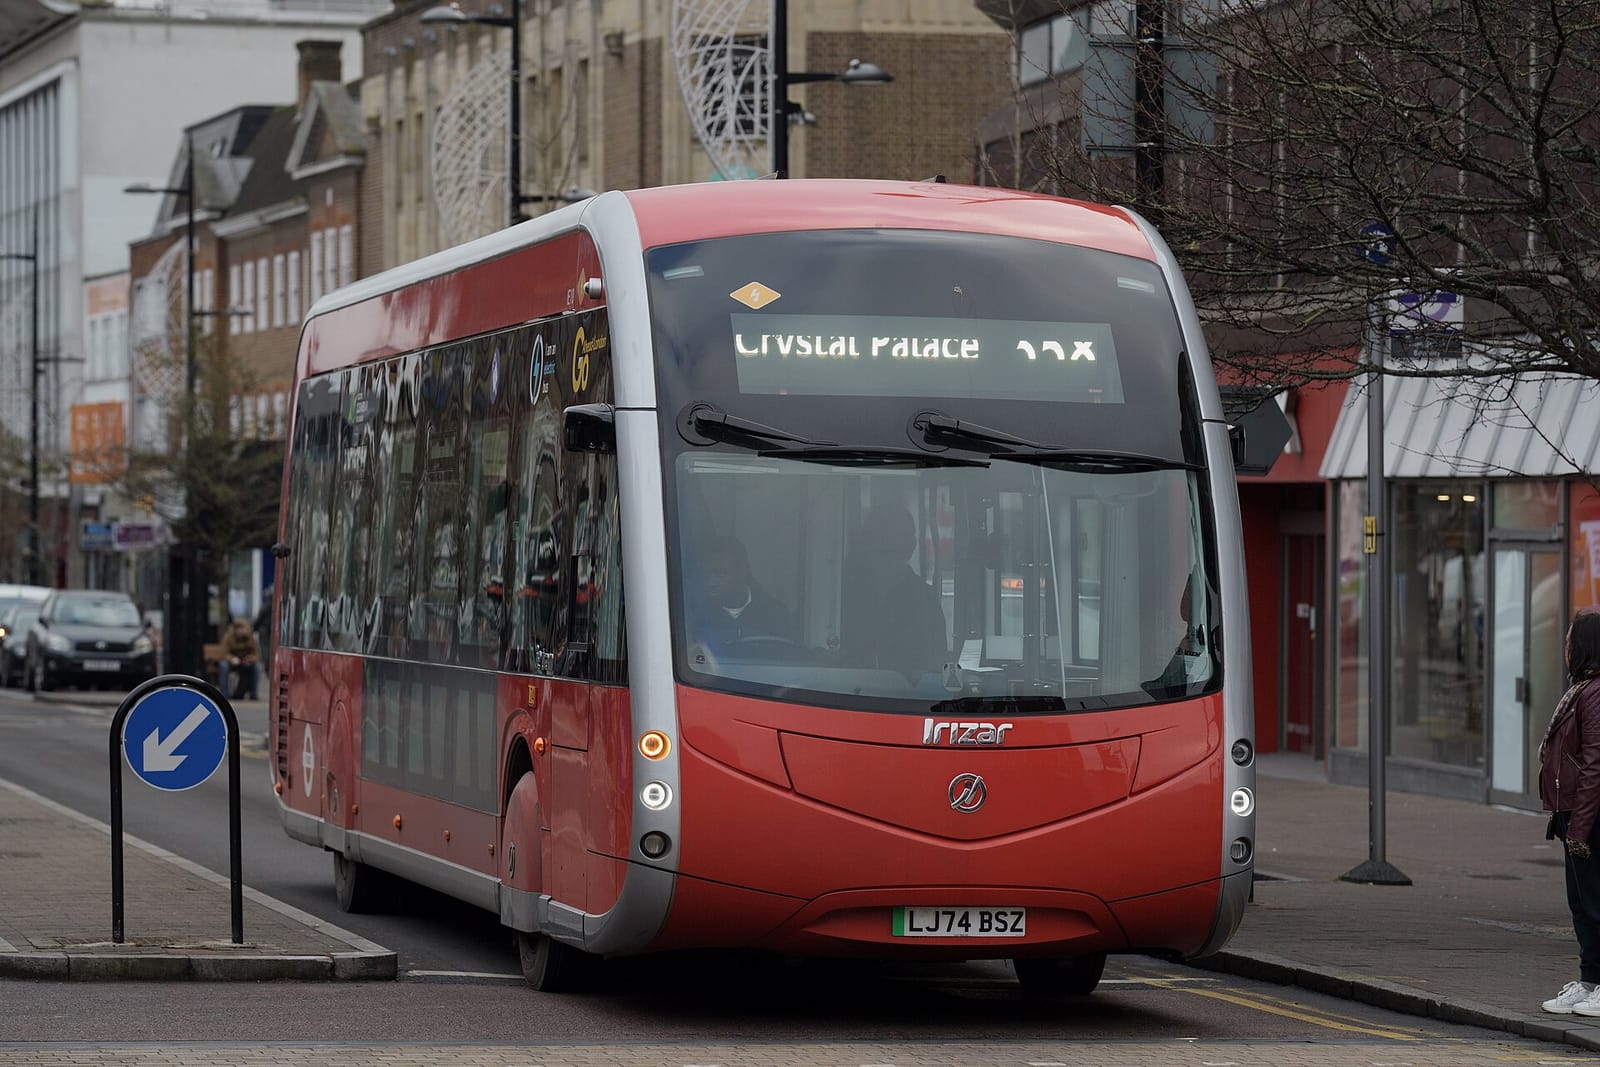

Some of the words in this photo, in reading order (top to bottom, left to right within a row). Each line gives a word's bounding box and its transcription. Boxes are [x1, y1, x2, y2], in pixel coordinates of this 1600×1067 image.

[573, 326, 589, 392] Go
[923, 718, 1013, 745] Irizar
[908, 910, 972, 932] LJ74
[978, 910, 1024, 932] BSZ
